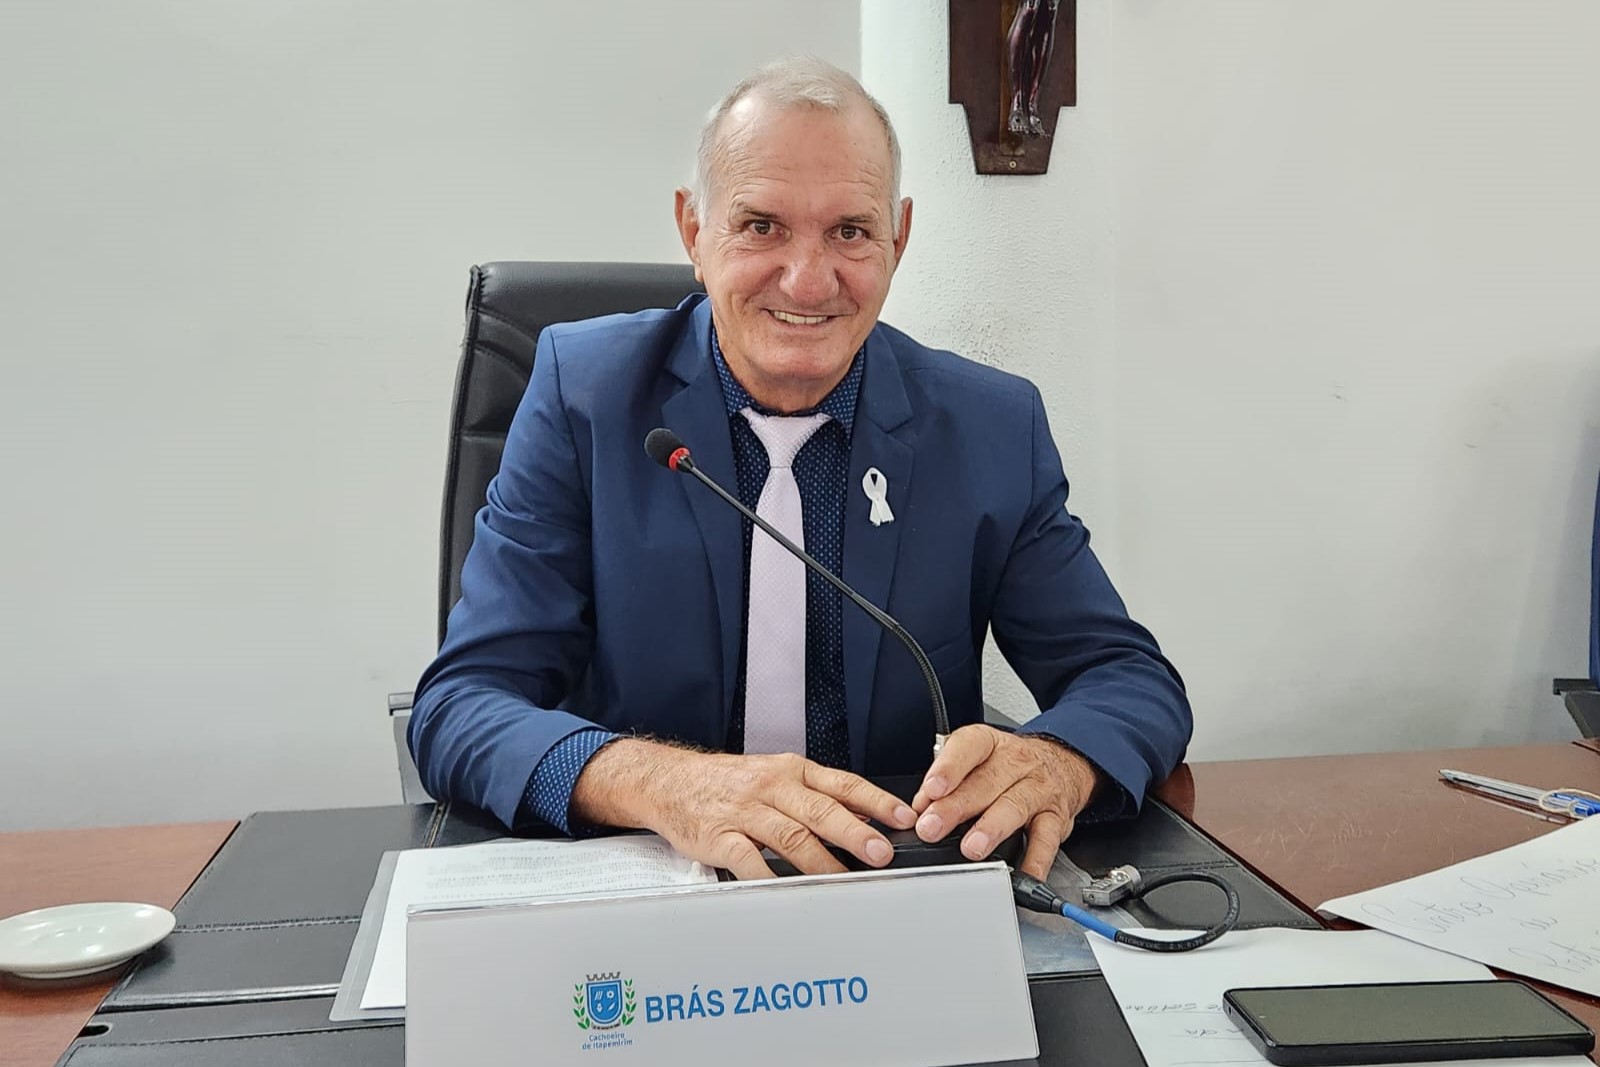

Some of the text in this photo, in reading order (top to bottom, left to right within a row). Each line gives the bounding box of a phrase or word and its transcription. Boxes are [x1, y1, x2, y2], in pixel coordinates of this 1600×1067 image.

[645, 976, 869, 1023] BRÁS ZAGOTTO
[588, 1031, 625, 1042] Cachoeiro
[582, 1041, 591, 1050] de
